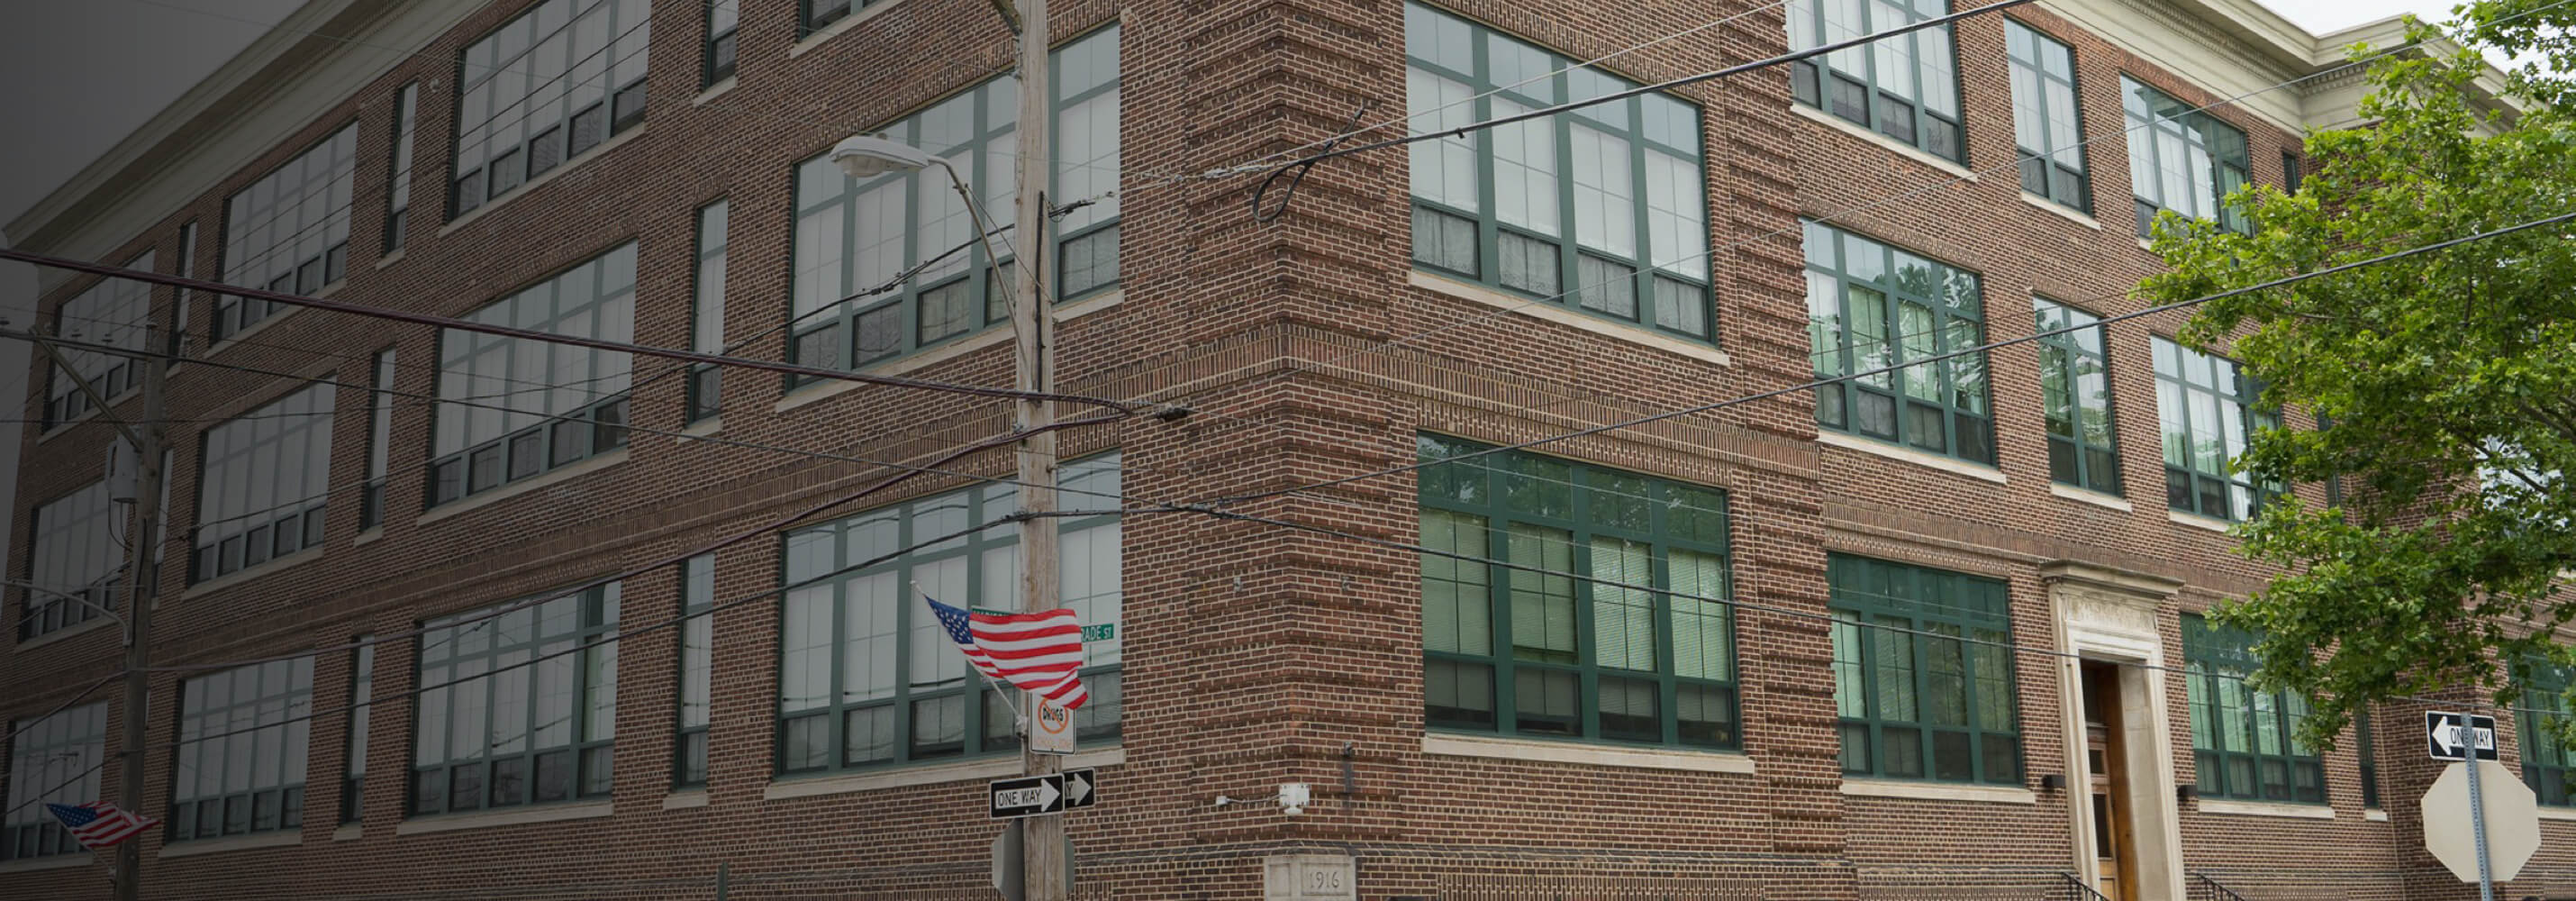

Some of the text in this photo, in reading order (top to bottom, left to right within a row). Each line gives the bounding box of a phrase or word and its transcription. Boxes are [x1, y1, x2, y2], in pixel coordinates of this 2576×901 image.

[1042, 707, 1064, 721] DRUGS
[2450, 727, 2465, 744] ON
[998, 788, 1041, 806] ONE WAY
[1310, 871, 1340, 888] 1916
